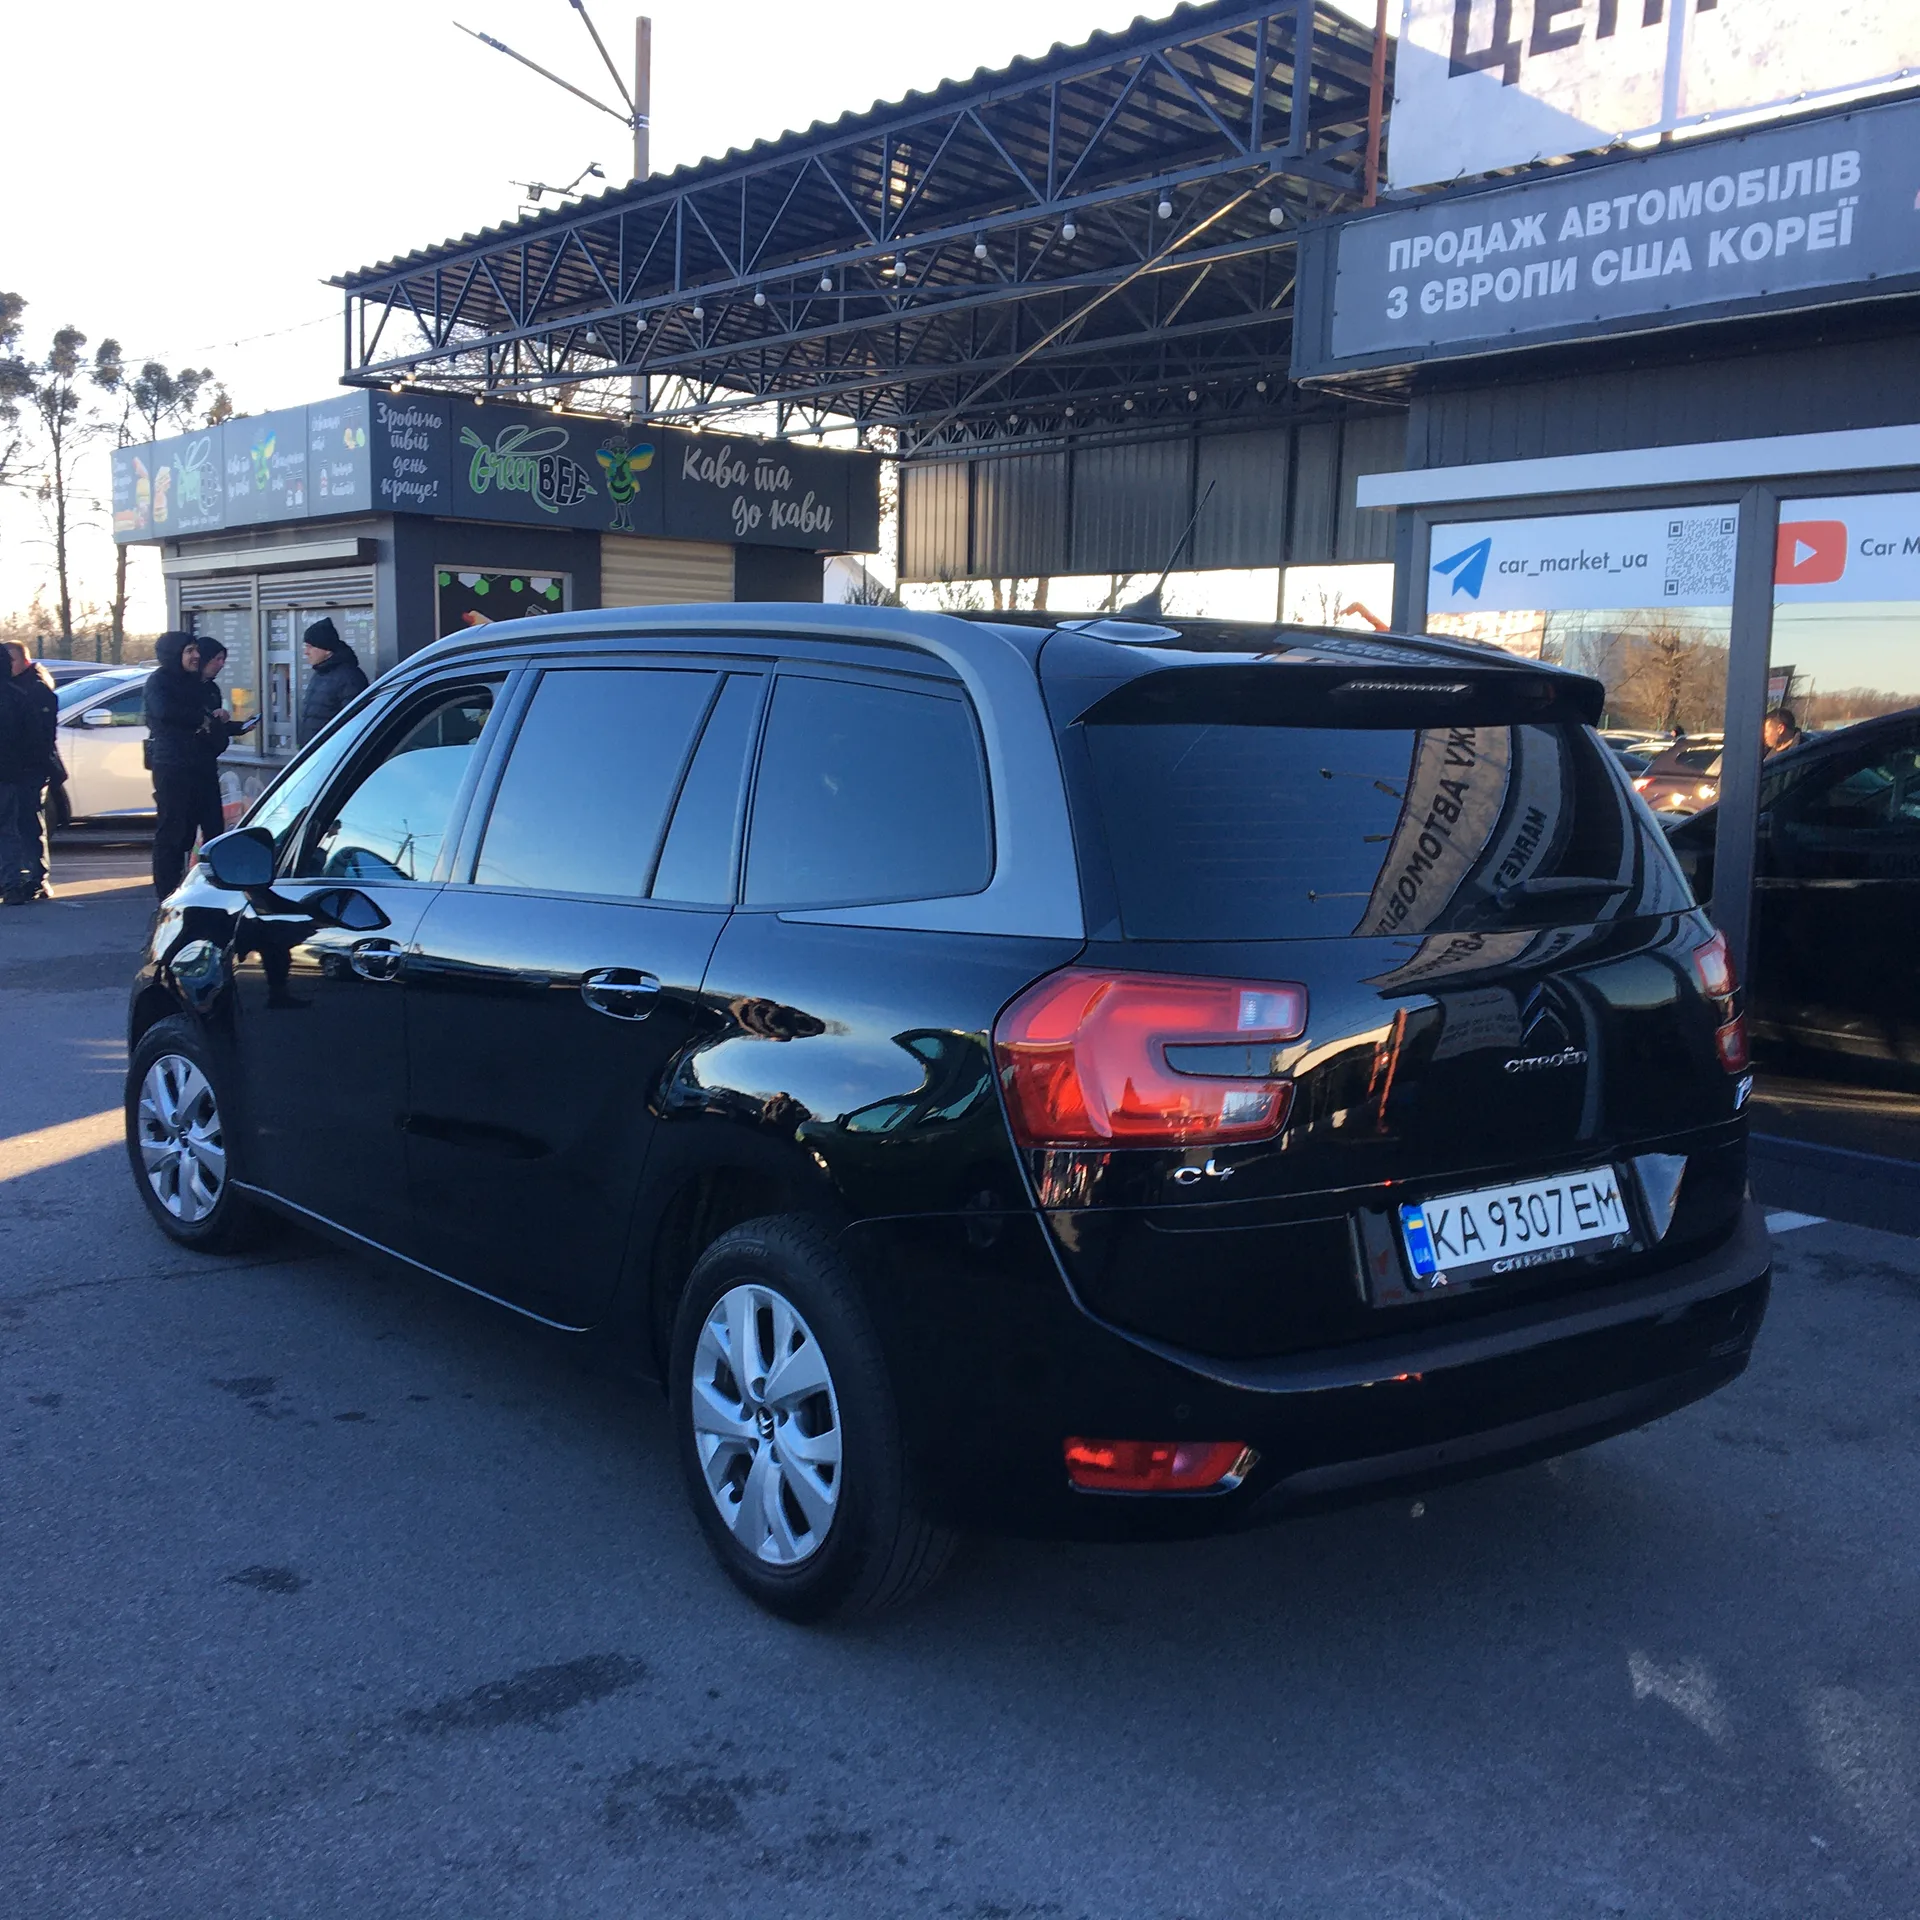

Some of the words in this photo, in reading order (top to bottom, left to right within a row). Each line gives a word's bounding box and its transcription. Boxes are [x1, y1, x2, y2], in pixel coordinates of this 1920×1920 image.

[1388, 211, 1548, 273] ПРОДАЖ
[1558, 149, 1862, 243] АВТОМОБІЛІВ
[1385, 287, 1409, 320] З
[1420, 260, 1578, 315] ЄВРОПИ
[1591, 240, 1693, 287] США
[1707, 196, 1861, 268] КОРЕЇ
[376, 402, 443, 432] Зробимо
[390, 430, 430, 452] твій
[392, 456, 428, 478] день
[682, 445, 750, 489] Кава
[754, 457, 793, 492] та
[380, 476, 439, 504] краще!
[731, 495, 763, 537] до
[768, 490, 834, 533] кави
[1860, 537, 1898, 557] Car
[1499, 549, 1649, 577] car_market_ua
[1173, 1159, 1236, 1185] C4
